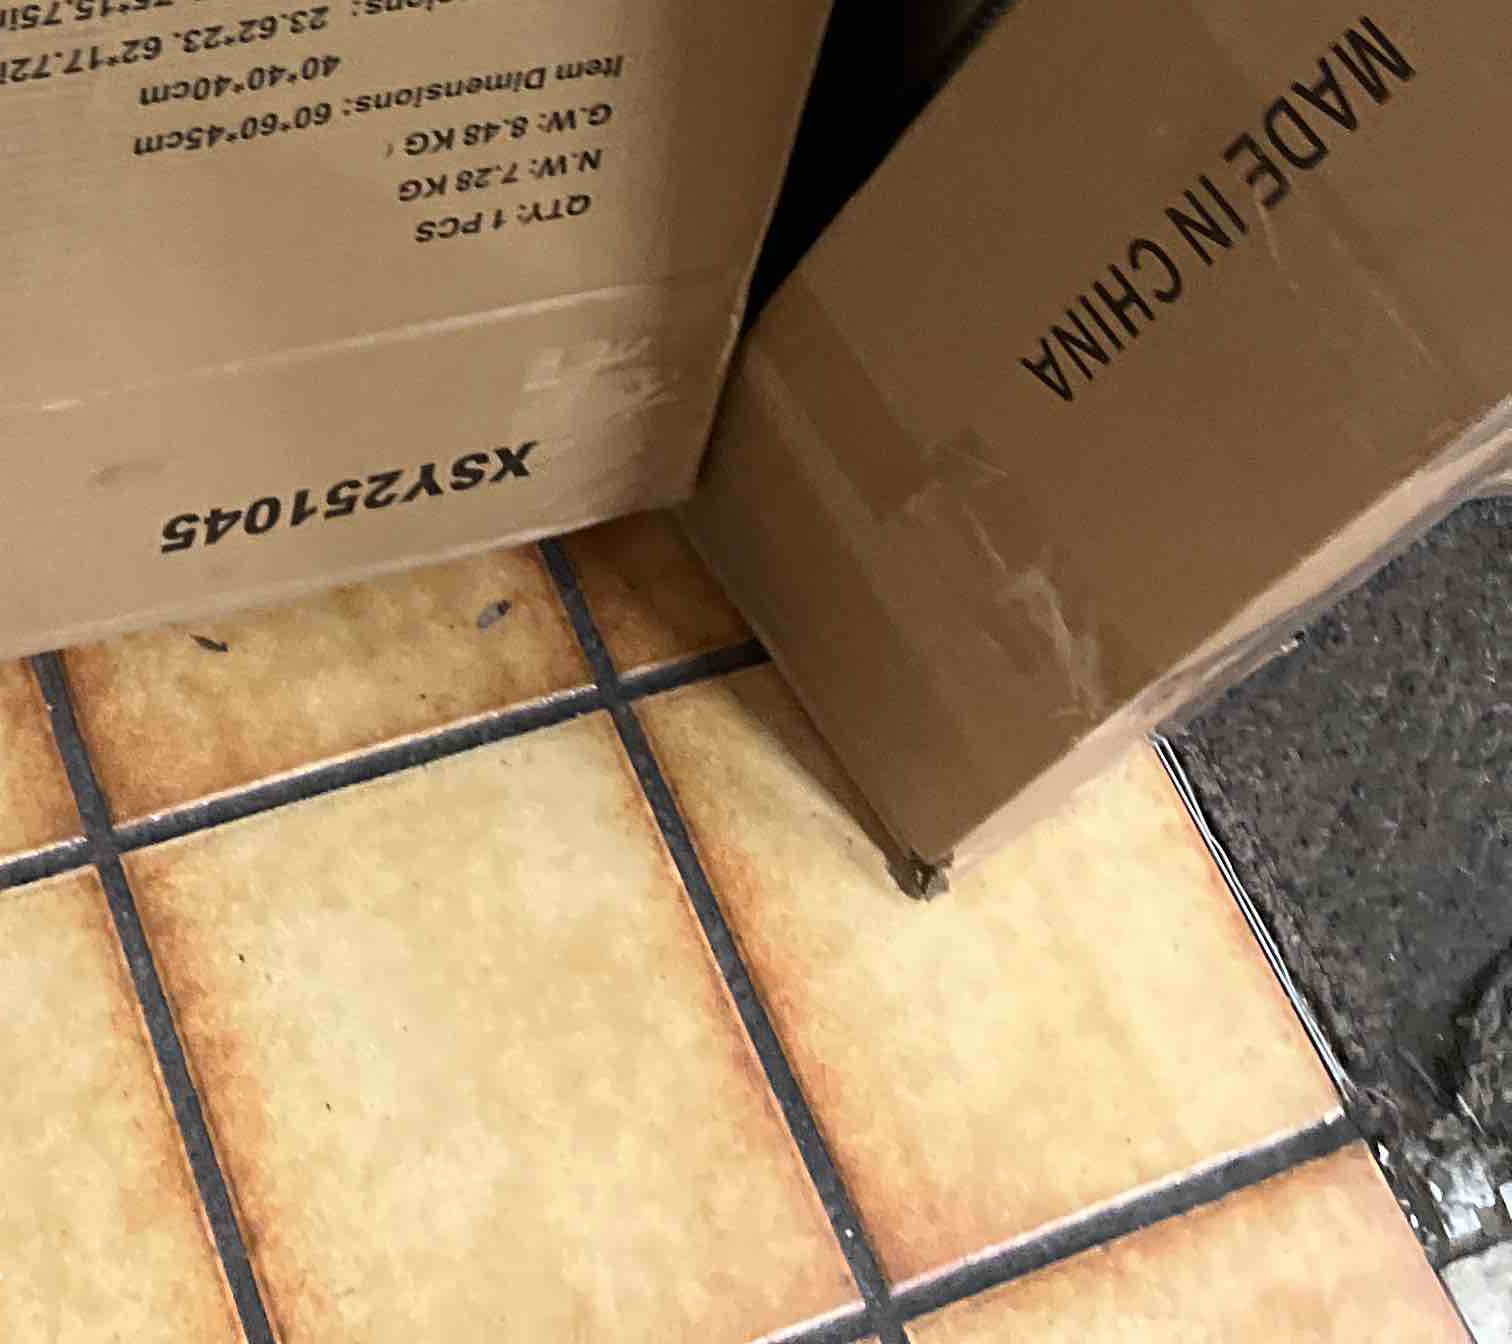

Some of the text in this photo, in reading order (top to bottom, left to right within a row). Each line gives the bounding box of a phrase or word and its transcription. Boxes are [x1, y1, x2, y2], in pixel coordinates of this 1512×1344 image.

[343, 65, 548, 116] Dimensions:
[554, 53, 625, 81] Item
[402, 101, 615, 157] G.W: 8.48 KG
[396, 147, 604, 203] N.W: 7.28 KG
[413, 211, 483, 245] PCS
[516, 192, 594, 224] QTY:
[1019, 15, 1417, 403] MADE IN CHINA
[159, 439, 540, 554] XSY251045
